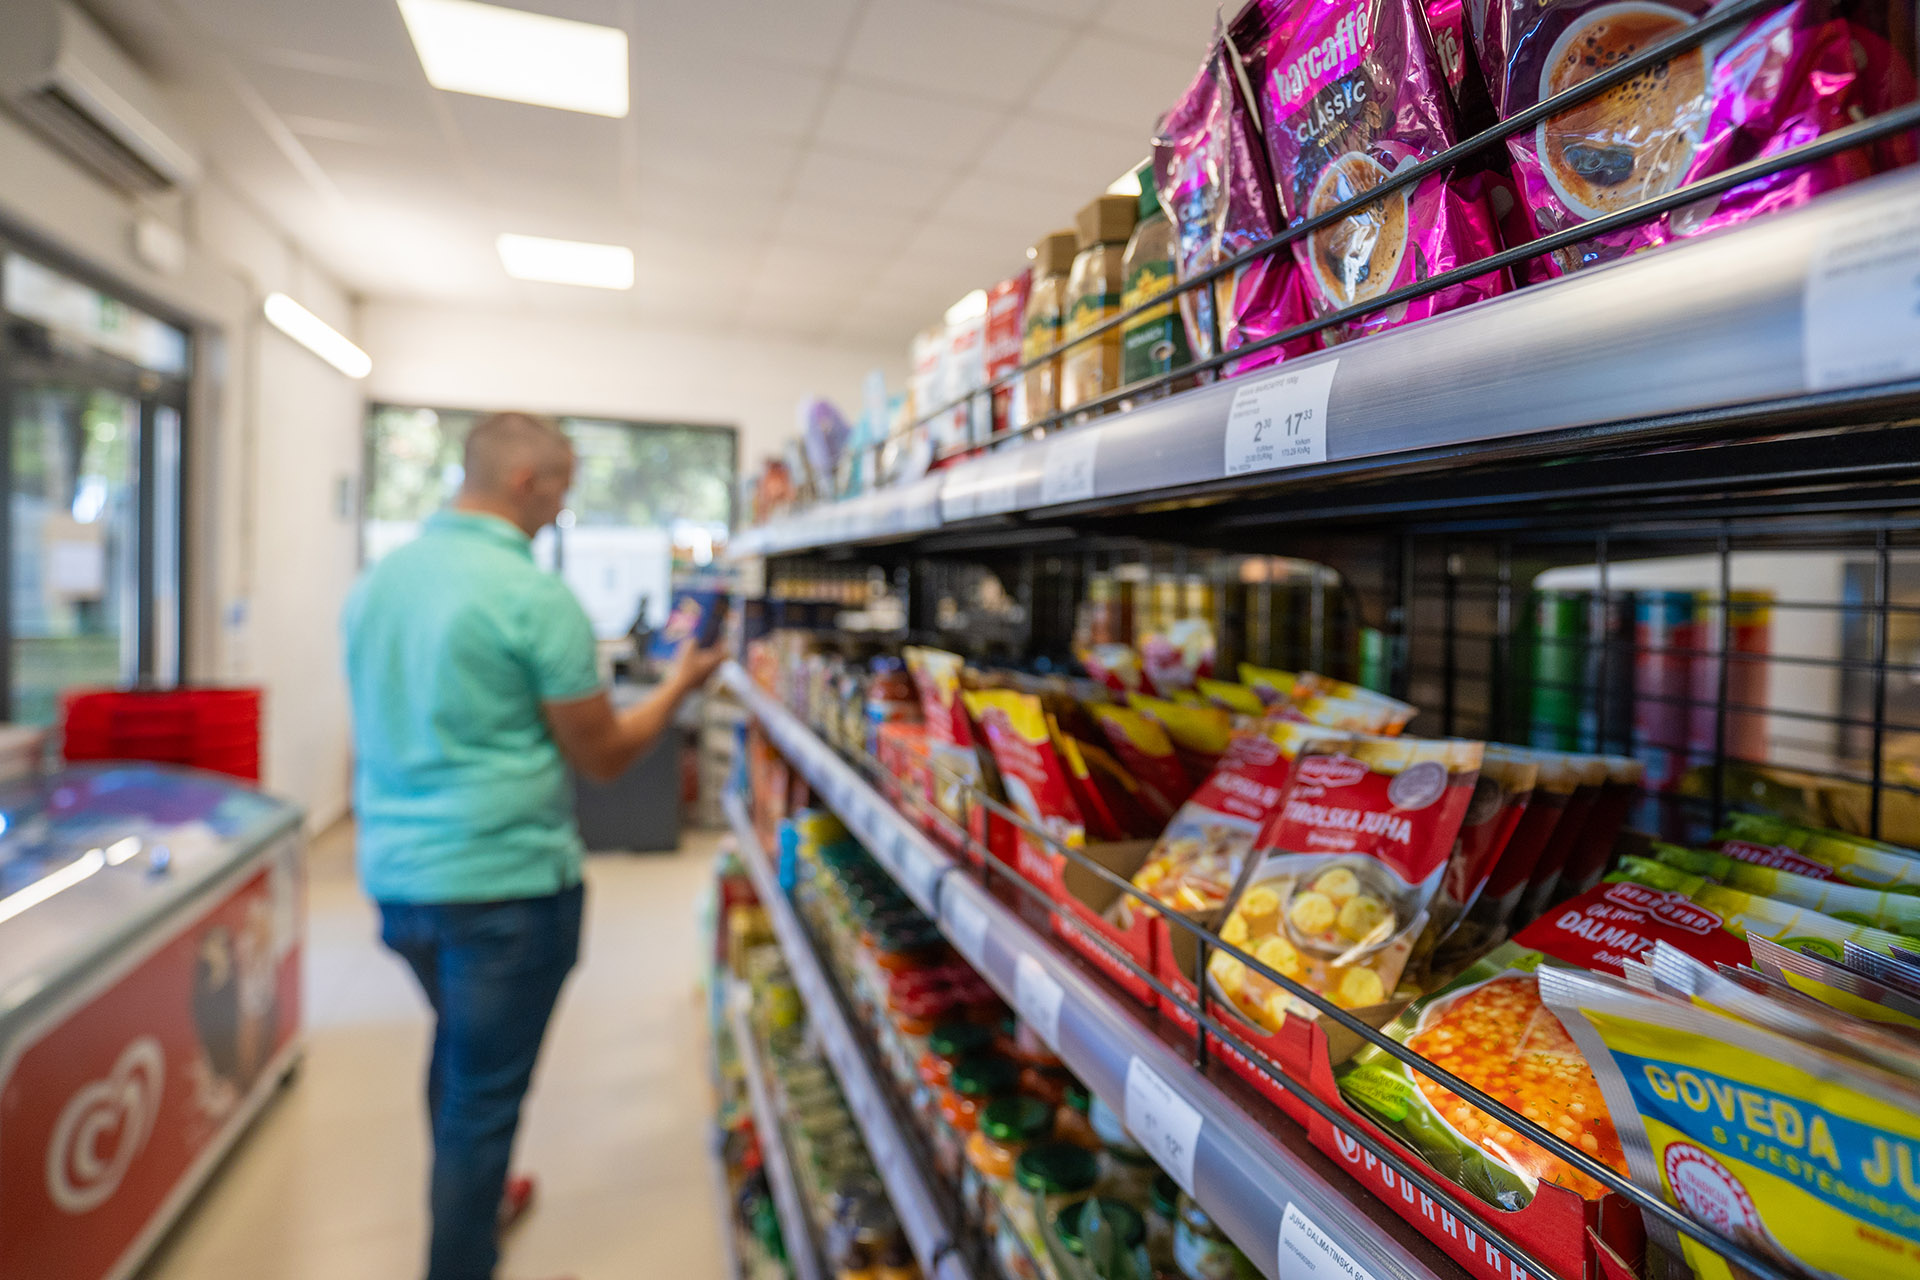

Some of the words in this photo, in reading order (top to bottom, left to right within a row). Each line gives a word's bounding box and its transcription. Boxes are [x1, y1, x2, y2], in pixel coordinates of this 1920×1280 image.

[1272, 2, 1369, 106] barcaffé
[1296, 80, 1366, 143] CLASSIC
[1317, 119, 1349, 148] ORIGINAL
[1358, 811, 1411, 844] JUHA
[1555, 910, 1655, 955] DALMAT
[1711, 1125, 1728, 1144] S
[1289, 1212, 1306, 1230] JUHA
[1306, 1227, 1354, 1277] DALMATINSKA
